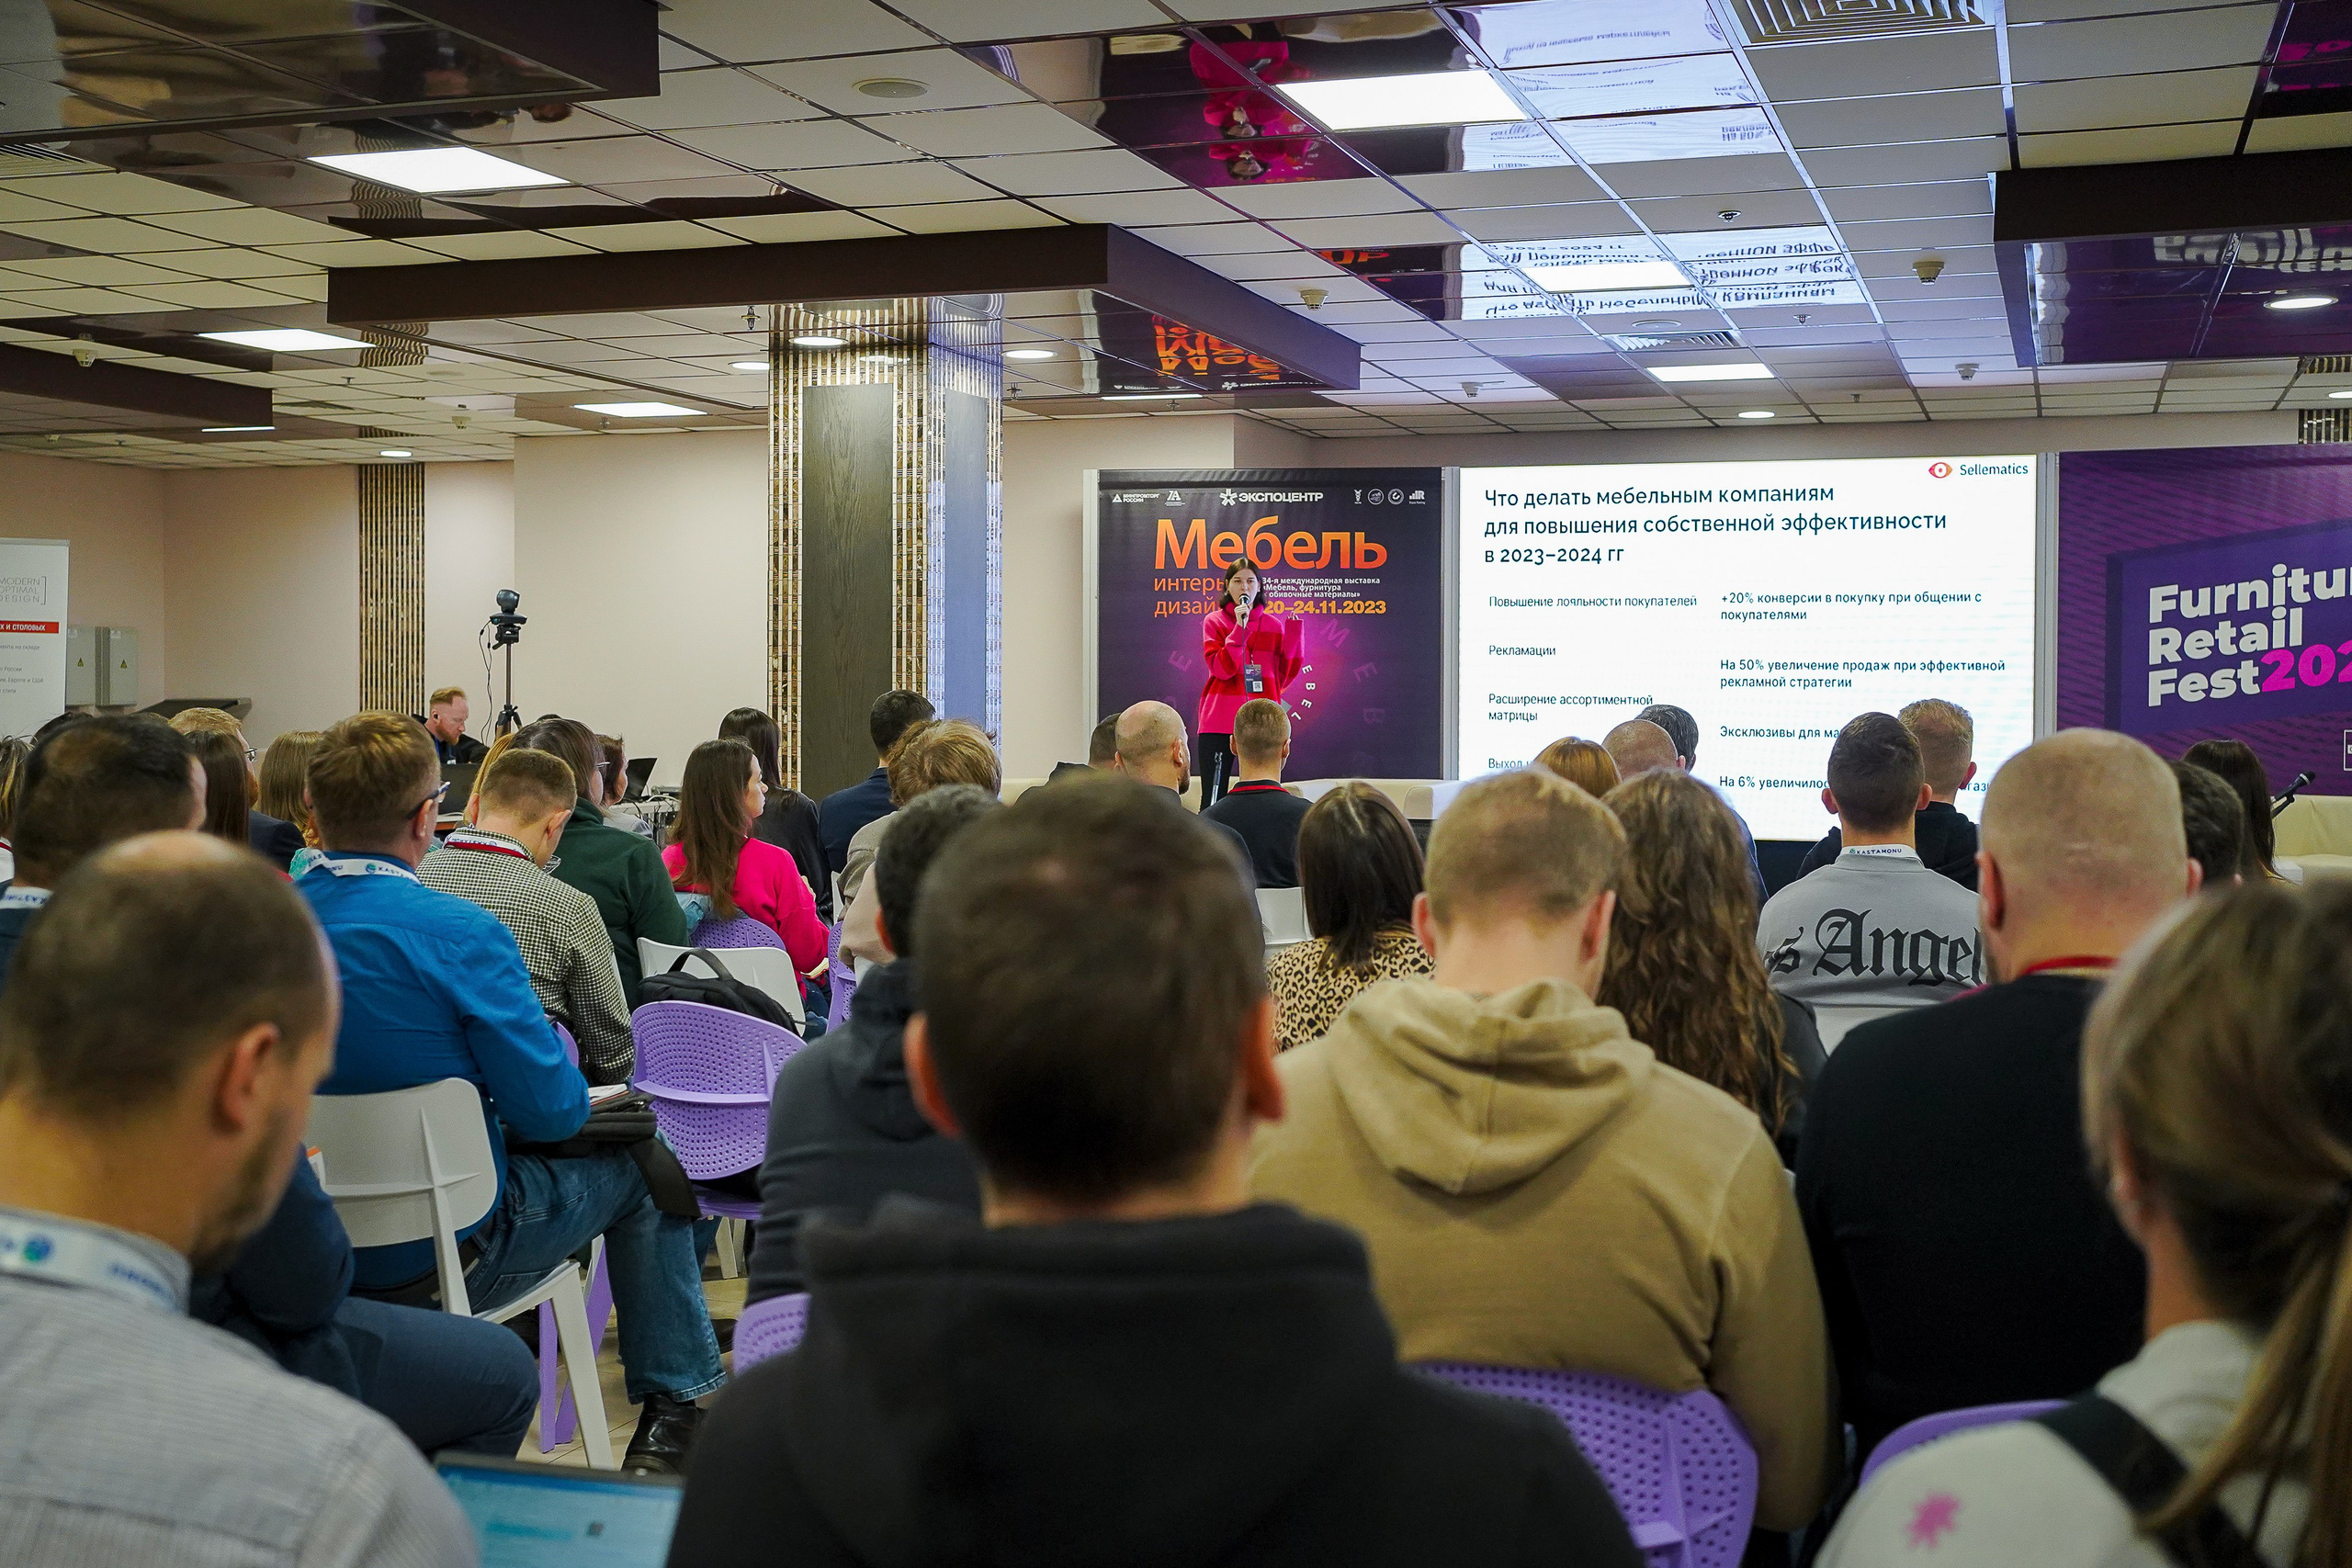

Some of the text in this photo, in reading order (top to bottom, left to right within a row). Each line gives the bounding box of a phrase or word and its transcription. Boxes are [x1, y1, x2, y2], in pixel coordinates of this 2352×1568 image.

[1961, 463, 2028, 475] Sellematics
[1238, 491, 1324, 503] ЭКСПОЦЕНТР
[1486, 487, 1833, 509] Что делать мебельным компаниям
[1485, 513, 1946, 537] для повышения собственной эффективности
[1154, 515, 1388, 570] Мебель
[1486, 548, 1623, 565] в 2023–2024 гг
[1154, 577, 1224, 595] интерь
[1299, 584, 1341, 592] фурнитура
[1314, 591, 1361, 599] материалы»
[1722, 592, 1981, 605] +20% конверсии в покупку при общении с
[2148, 563, 2352, 624] Furnitu
[1154, 596, 1220, 618] дизай
[1490, 596, 1696, 608] Повышение лояльности покупателей
[1722, 612, 1806, 623] покупателями
[2148, 606, 2303, 666] Retail
[1489, 646, 1555, 657] Рекламации
[1721, 660, 2005, 672] На 50% увеличение продаж при эффективной
[1721, 677, 1851, 690] рекламной стратегии
[1489, 694, 1654, 707] Расширение ассортиментной
[1489, 712, 1537, 722] матрицы
[1721, 726, 1794, 738] Эксклюзивы
[1799, 729, 1820, 739] для
[1720, 776, 1734, 786] На
[1738, 776, 1755, 787] 6%
[1759, 778, 1828, 790] увеличилос
[1856, 847, 1902, 855] KASTAMONU
